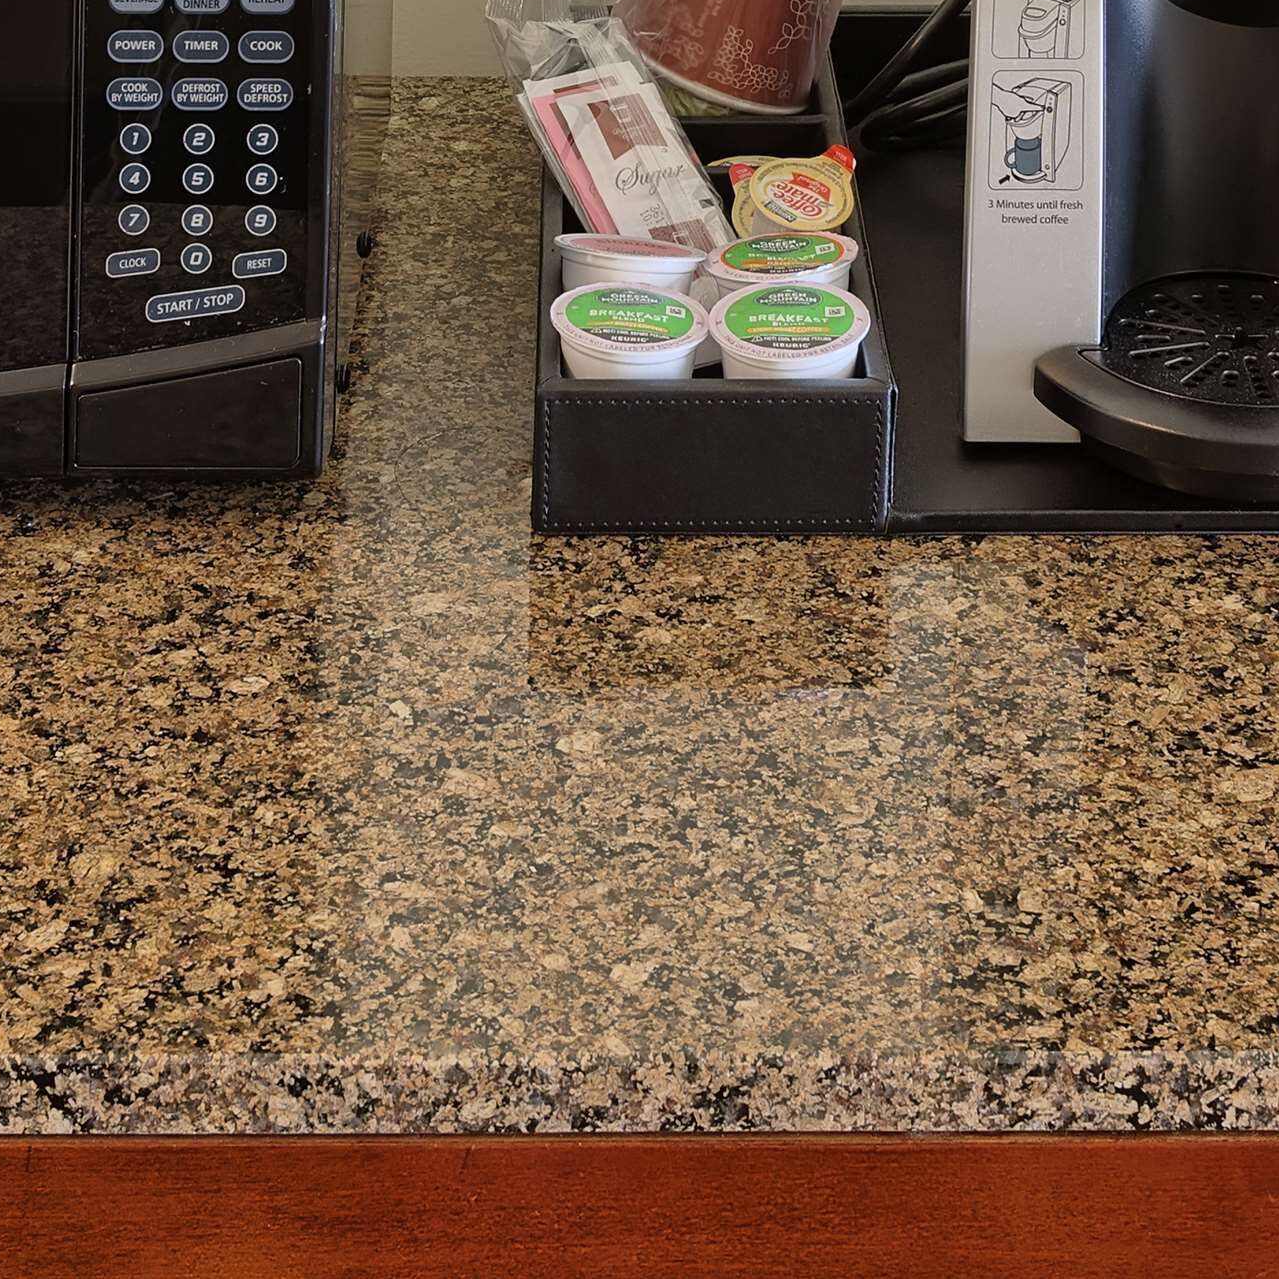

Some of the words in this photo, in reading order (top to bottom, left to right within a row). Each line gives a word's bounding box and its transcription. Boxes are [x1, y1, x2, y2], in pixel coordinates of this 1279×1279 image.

[183, 0, 220, 9] DINNER
[115, 40, 156, 50] POWER
[183, 40, 219, 51] TIMER
[250, 40, 282, 51] COOK
[121, 83, 148, 93] COOK
[182, 83, 220, 93] DEFROST
[250, 84, 281, 93] SPEED
[111, 93, 123, 103] BY
[124, 93, 158, 102] WEIGHT
[177, 93, 188, 102] BY
[190, 93, 224, 102] WEIGHT
[244, 93, 288, 103] DEFROST
[131, 133, 139, 145] 1
[192, 133, 206, 145] 2
[256, 133, 270, 146] 3
[129, 172, 140, 184] 4
[191, 172, 204, 185] 5
[255, 173, 268, 185] 6
[615, 161, 685, 196] Sugar
[988, 200, 994, 209] 3
[996, 199, 1035, 209] Minutes
[1036, 200, 1058, 210] until
[1059, 200, 1083, 210] fresh
[128, 214, 140, 226] 7
[191, 214, 204, 226] 8
[254, 214, 268, 226] 9
[1001, 214, 1038, 224] brewed
[1039, 214, 1069, 224] coffee
[120, 257, 147, 269] CLOCK
[247, 257, 272, 269] RESET
[157, 299, 193, 314] START
[203, 293, 234, 308] STOP
[589, 308, 670, 323] BREAKFAST
[749, 313, 829, 323] BREAKFAST
